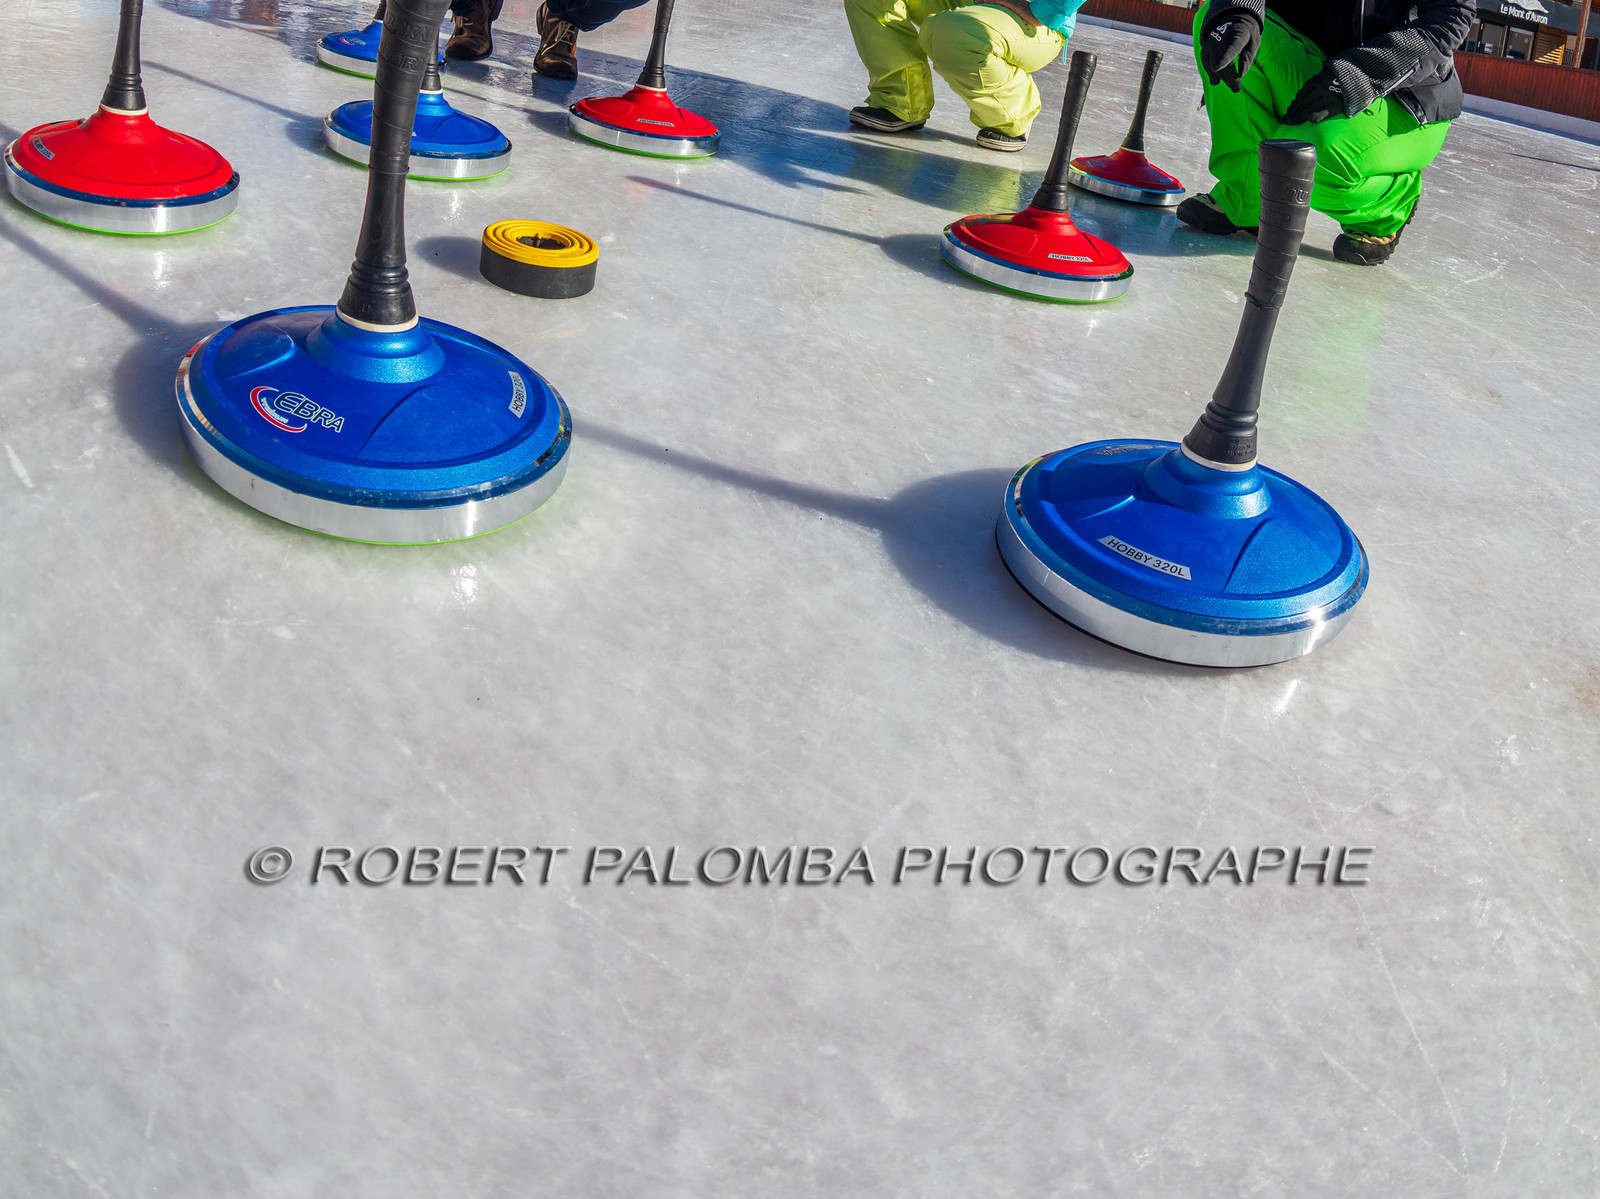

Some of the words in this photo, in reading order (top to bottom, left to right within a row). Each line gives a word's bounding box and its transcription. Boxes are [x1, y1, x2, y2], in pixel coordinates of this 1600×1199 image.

[1500, 4, 1508, 14] Le
[1509, 6, 1524, 19] Mont
[1525, 10, 1548, 25] d'Auron
[274, 391, 345, 433] EBRA
[512, 389, 524, 412] HOBBY
[1107, 538, 1152, 563] HOBBY
[1153, 560, 1185, 576] 320L
